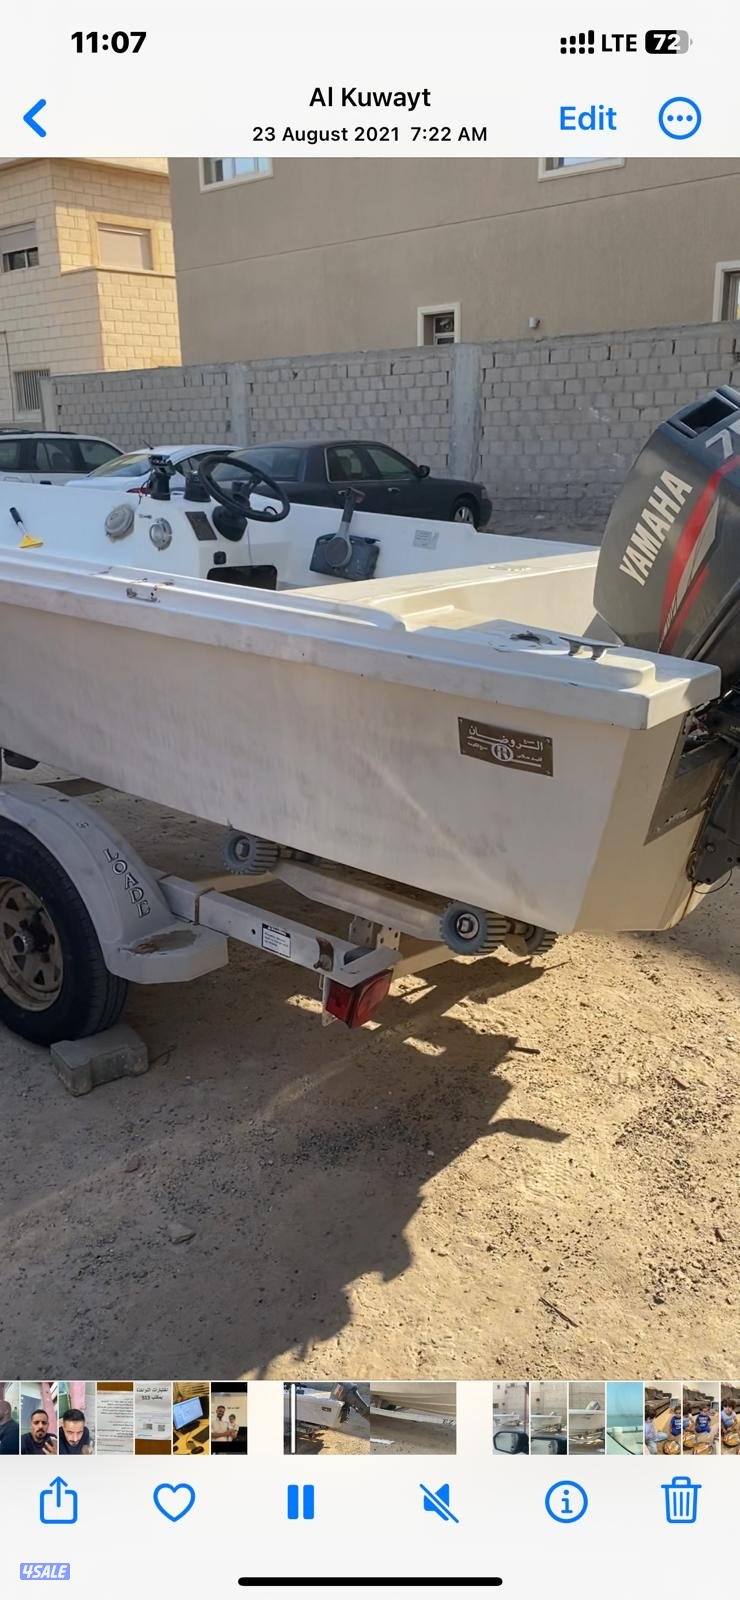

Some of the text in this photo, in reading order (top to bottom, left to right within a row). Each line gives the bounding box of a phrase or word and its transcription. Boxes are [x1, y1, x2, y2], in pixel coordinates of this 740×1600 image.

[71, 31, 146, 53] 11:07
[601, 34, 638, 52] LTE
[653, 33, 681, 51] 72
[309, 87, 431, 112] Al Kuwayt
[559, 104, 618, 131] Edit
[252, 126, 488, 146] 23 August 2021 7:22 AM
[619, 469, 694, 587] YAMAHA
[103, 848, 151, 918] LOADE
